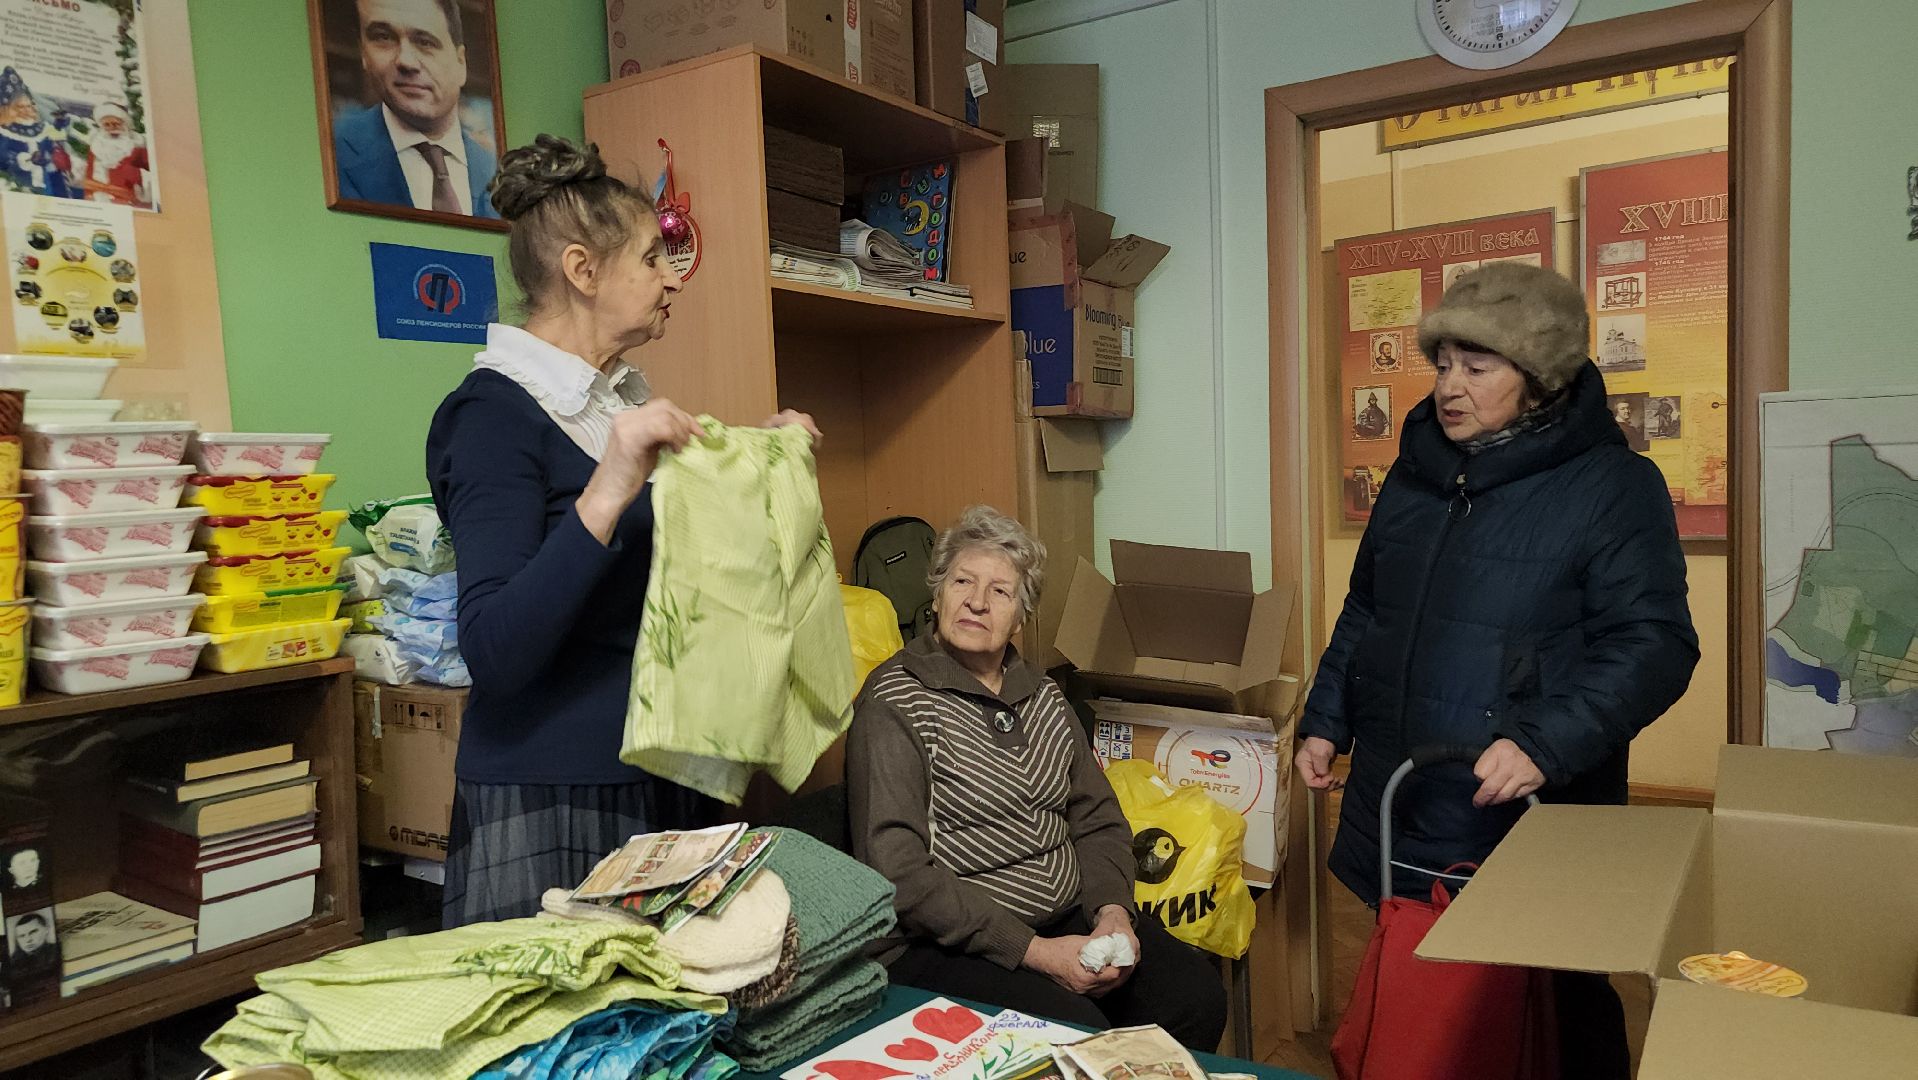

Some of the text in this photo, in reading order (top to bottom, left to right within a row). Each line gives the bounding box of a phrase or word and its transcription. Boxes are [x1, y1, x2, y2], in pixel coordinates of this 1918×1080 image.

[396, 317, 415, 325] СОЮЗ
[416, 319, 462, 329] ПЕНСИОНЕРОВ
[1086, 304, 1116, 331] Blooming
[999, 1013, 1021, 1022] 23
